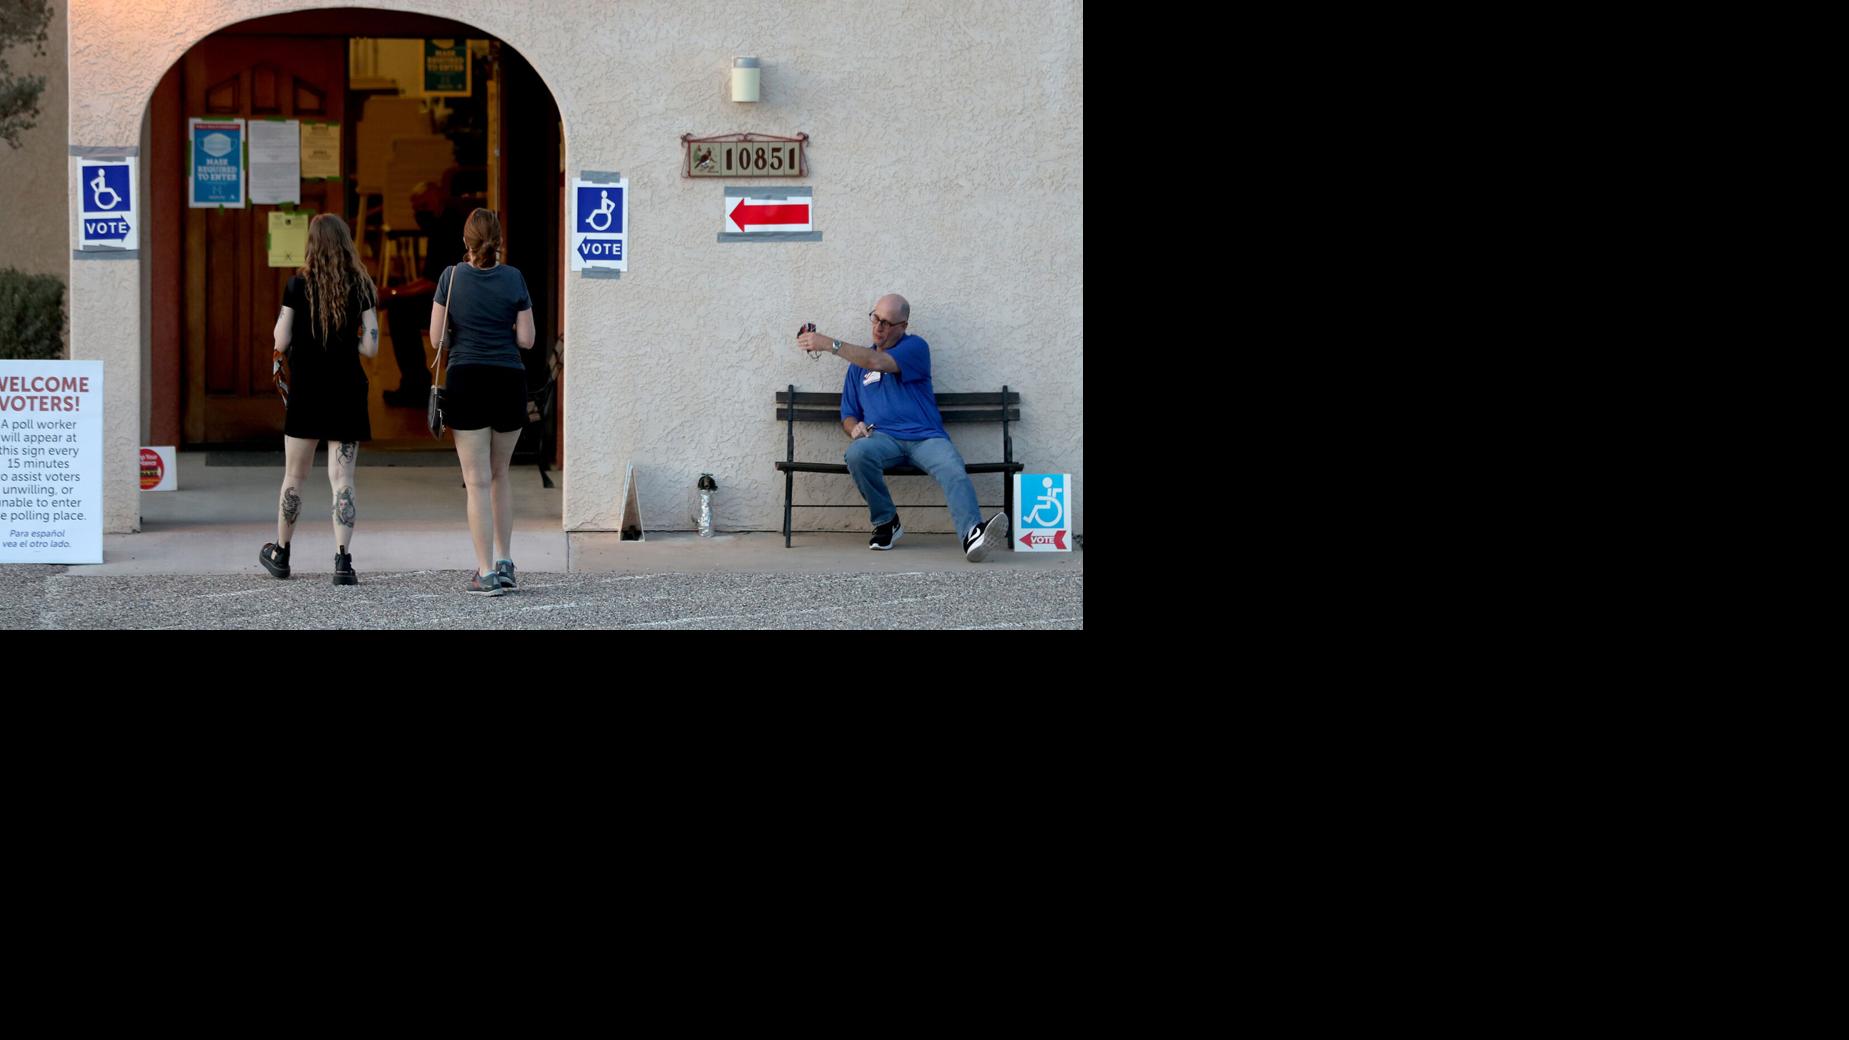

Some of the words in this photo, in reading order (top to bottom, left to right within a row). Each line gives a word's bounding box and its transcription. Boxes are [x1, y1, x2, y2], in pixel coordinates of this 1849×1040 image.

[726, 148, 796, 170] 10851
[86, 222, 128, 235] VOTE
[582, 243, 621, 255] VOTE
[0, 396, 80, 411] VOTERS!
[1, 420, 9, 429] A
[12, 419, 34, 431] poll
[37, 419, 77, 429] worker
[1, 432, 20, 442] will
[24, 434, 62, 445] appear
[66, 434, 77, 442] at
[22, 446, 45, 458] sign
[48, 447, 79, 458] every
[7, 458, 20, 468] 15
[23, 459, 70, 468] minutes
[0, 473, 9, 481] o
[11, 472, 42, 481] assist
[45, 473, 81, 481] voters
[2, 484, 58, 497] unwilling,
[61, 486, 74, 494] or
[0, 498, 33, 507] nable
[36, 499, 49, 507] to
[51, 499, 82, 507] enter
[10, 510, 50, 522] polling
[53, 510, 87, 522] place.
[9, 529, 29, 537] Para
[31, 529, 65, 539] español
[1031, 536, 1055, 544] VOTE
[50, 540, 72, 548] lado.
